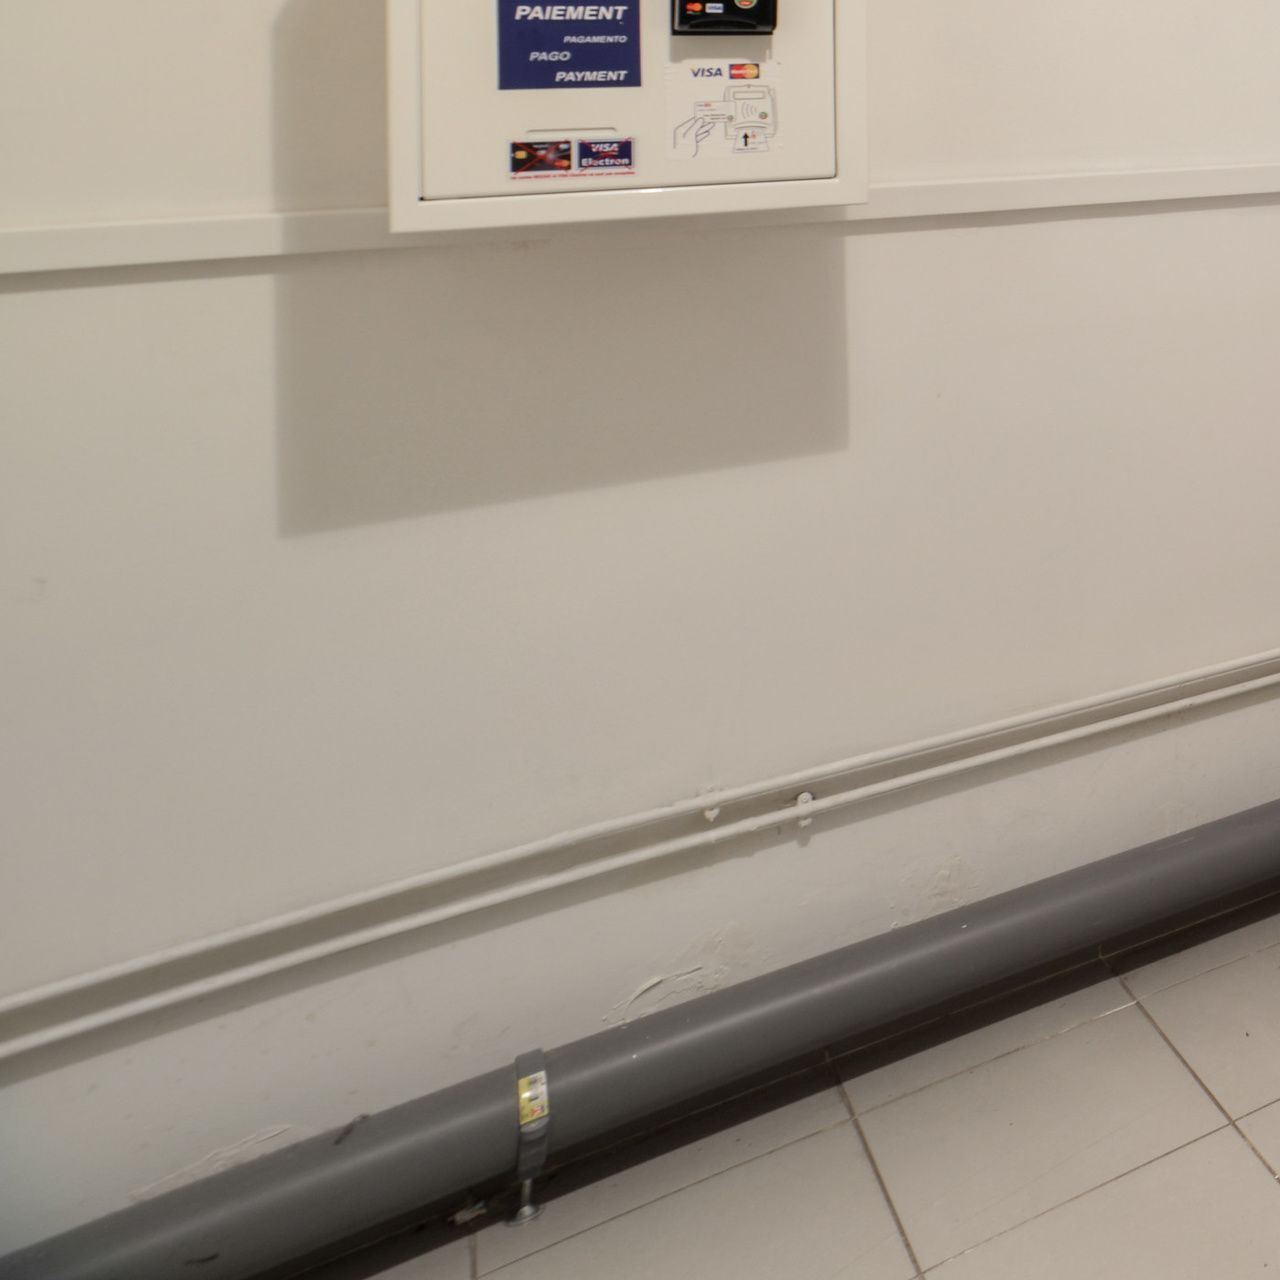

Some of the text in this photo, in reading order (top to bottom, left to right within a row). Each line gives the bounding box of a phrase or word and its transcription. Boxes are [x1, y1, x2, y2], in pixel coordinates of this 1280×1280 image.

[514, 5, 628, 20] PAIEMENT
[563, 35, 627, 43] PAGAMENTO
[529, 51, 571, 61] PAGO
[555, 70, 628, 82] PAYMENT
[691, 67, 723, 78] VISA
[581, 157, 630, 166] Electron
